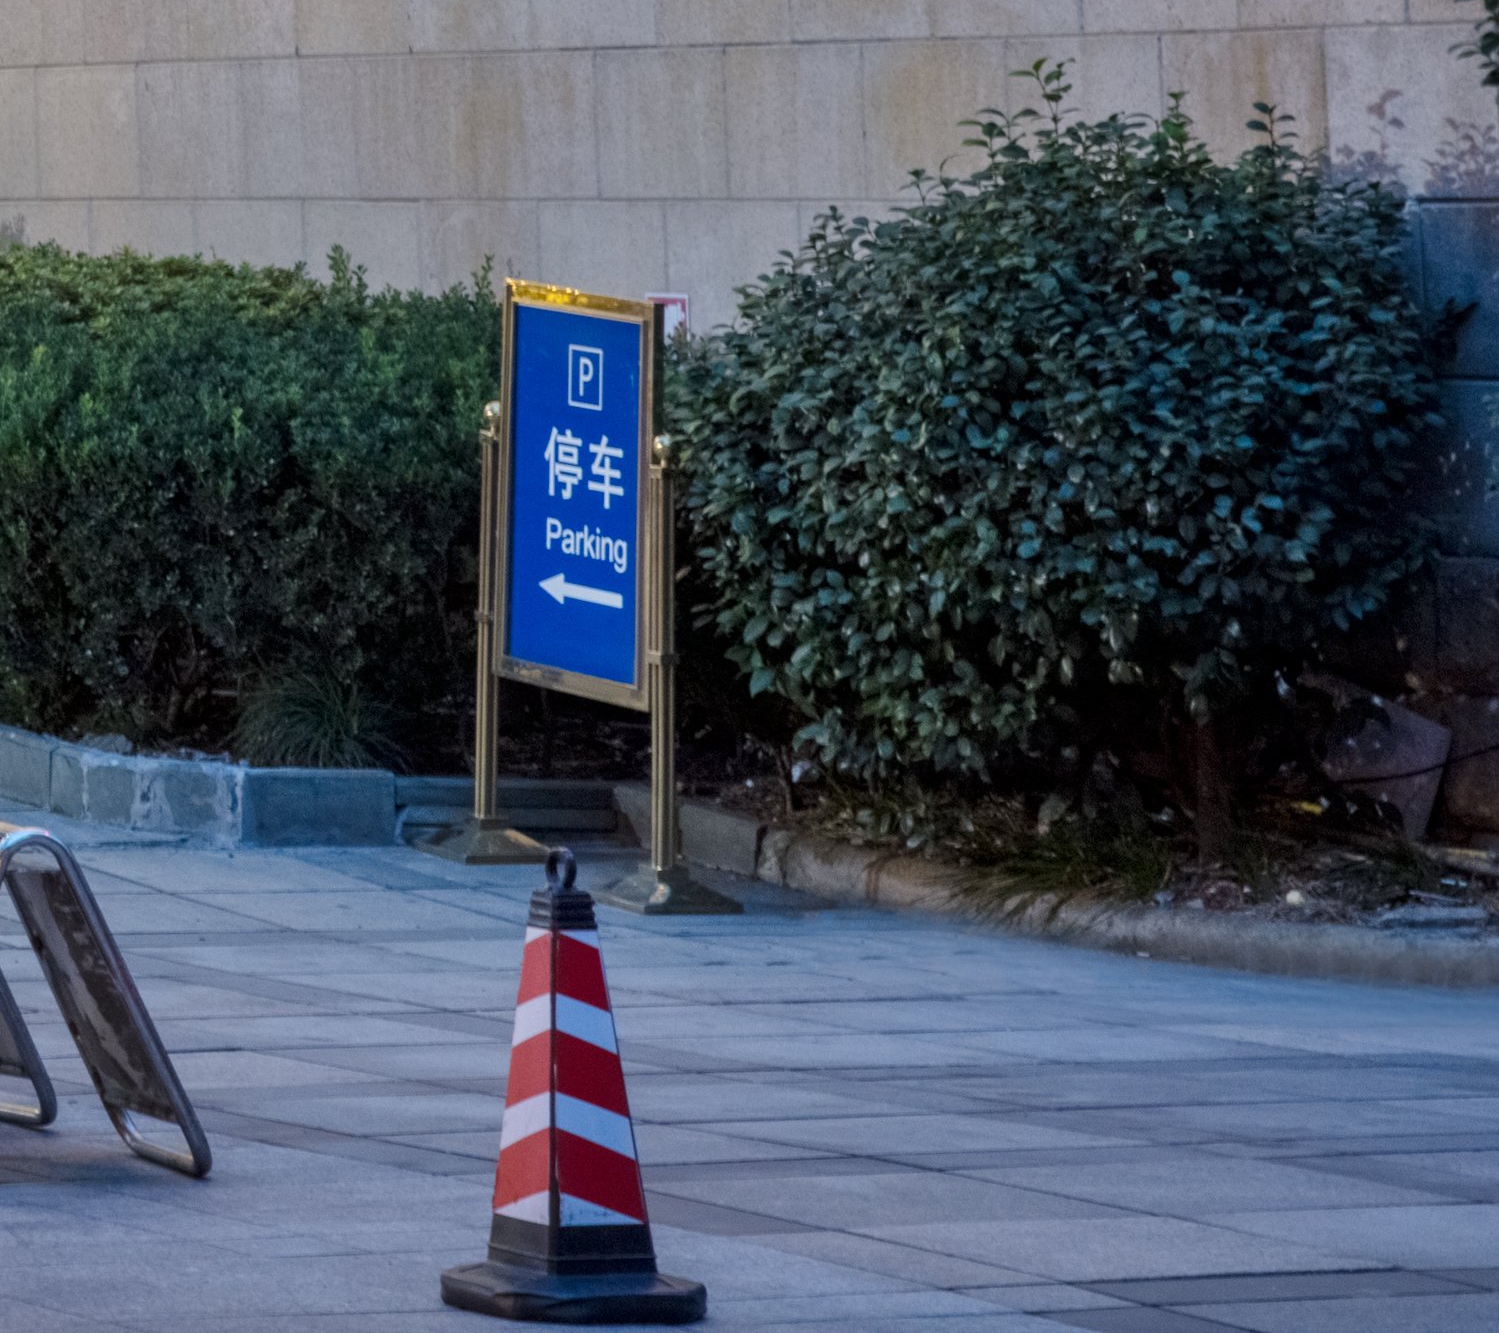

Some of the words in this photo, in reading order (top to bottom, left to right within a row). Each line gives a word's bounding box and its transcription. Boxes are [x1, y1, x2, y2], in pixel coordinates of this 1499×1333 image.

[578, 356, 594, 397] P
[544, 426, 625, 510] 停车
[545, 517, 628, 574] Parking
